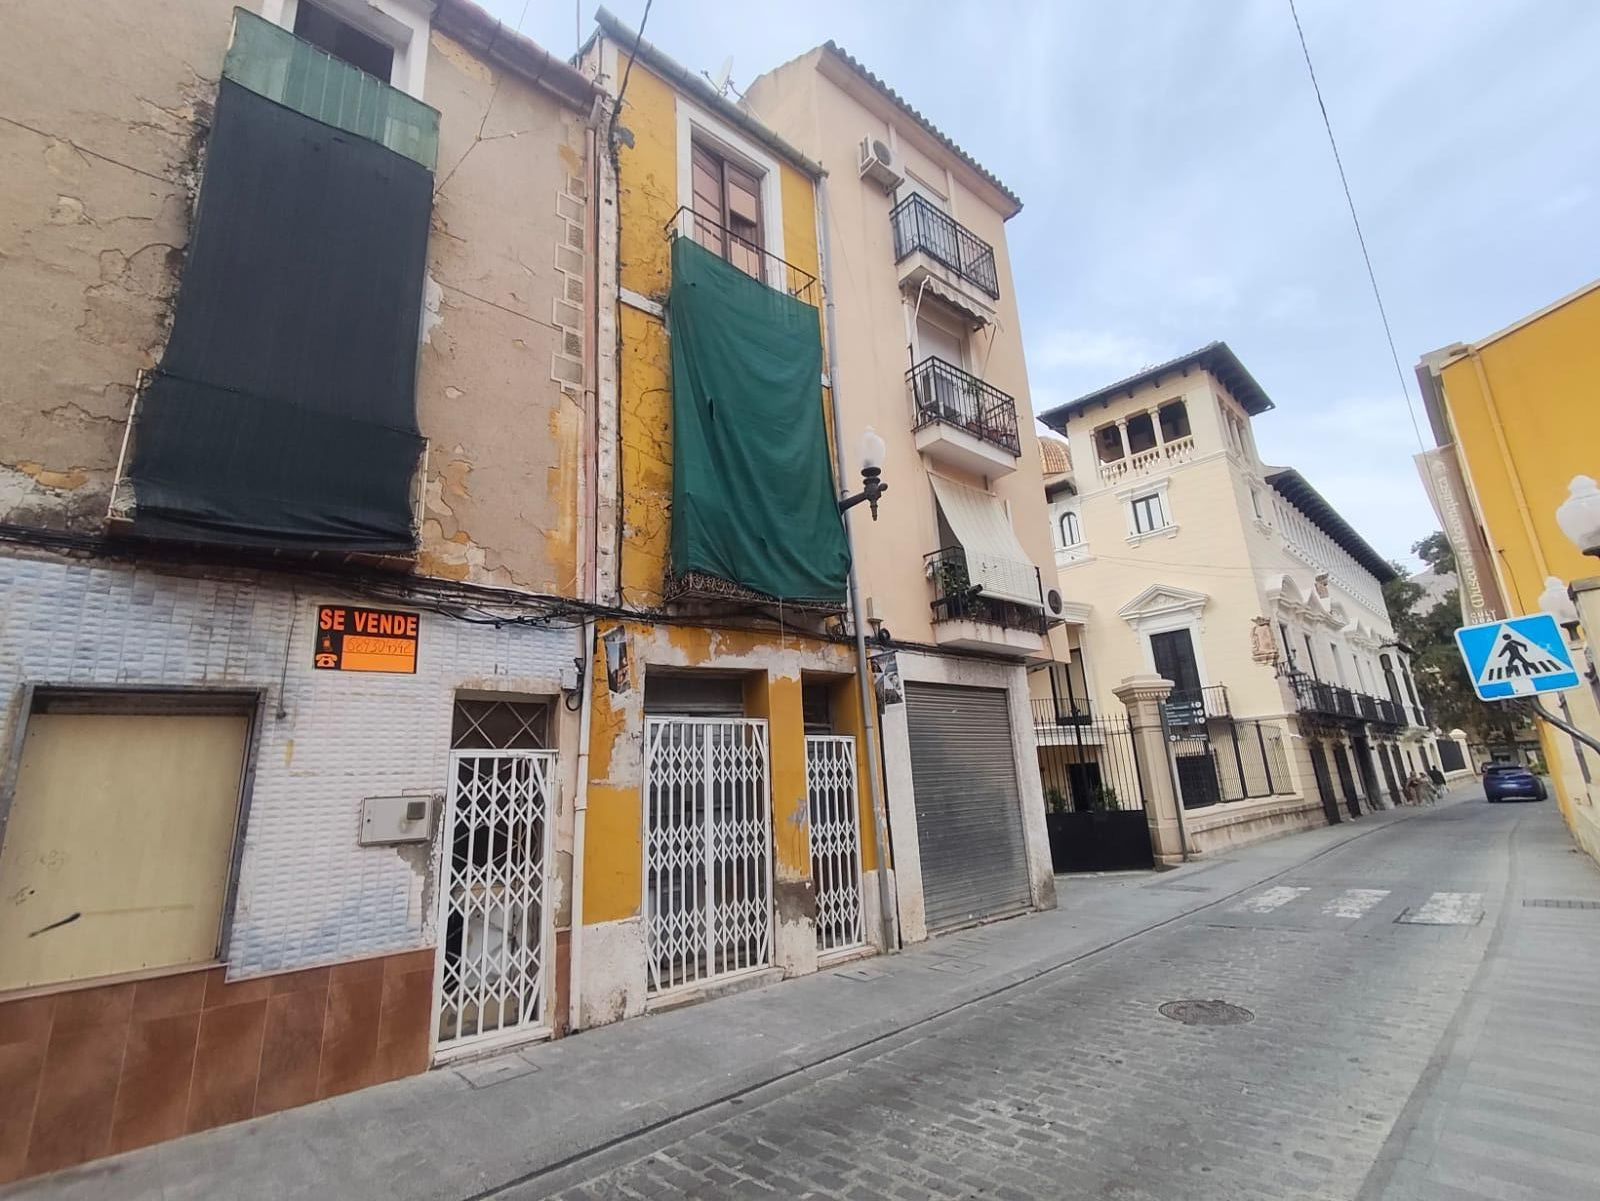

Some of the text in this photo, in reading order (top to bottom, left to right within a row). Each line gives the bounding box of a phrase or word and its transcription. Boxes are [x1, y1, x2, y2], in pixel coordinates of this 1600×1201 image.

[1465, 568, 1485, 608] Museo
[319, 608, 417, 636] SE VENDE
